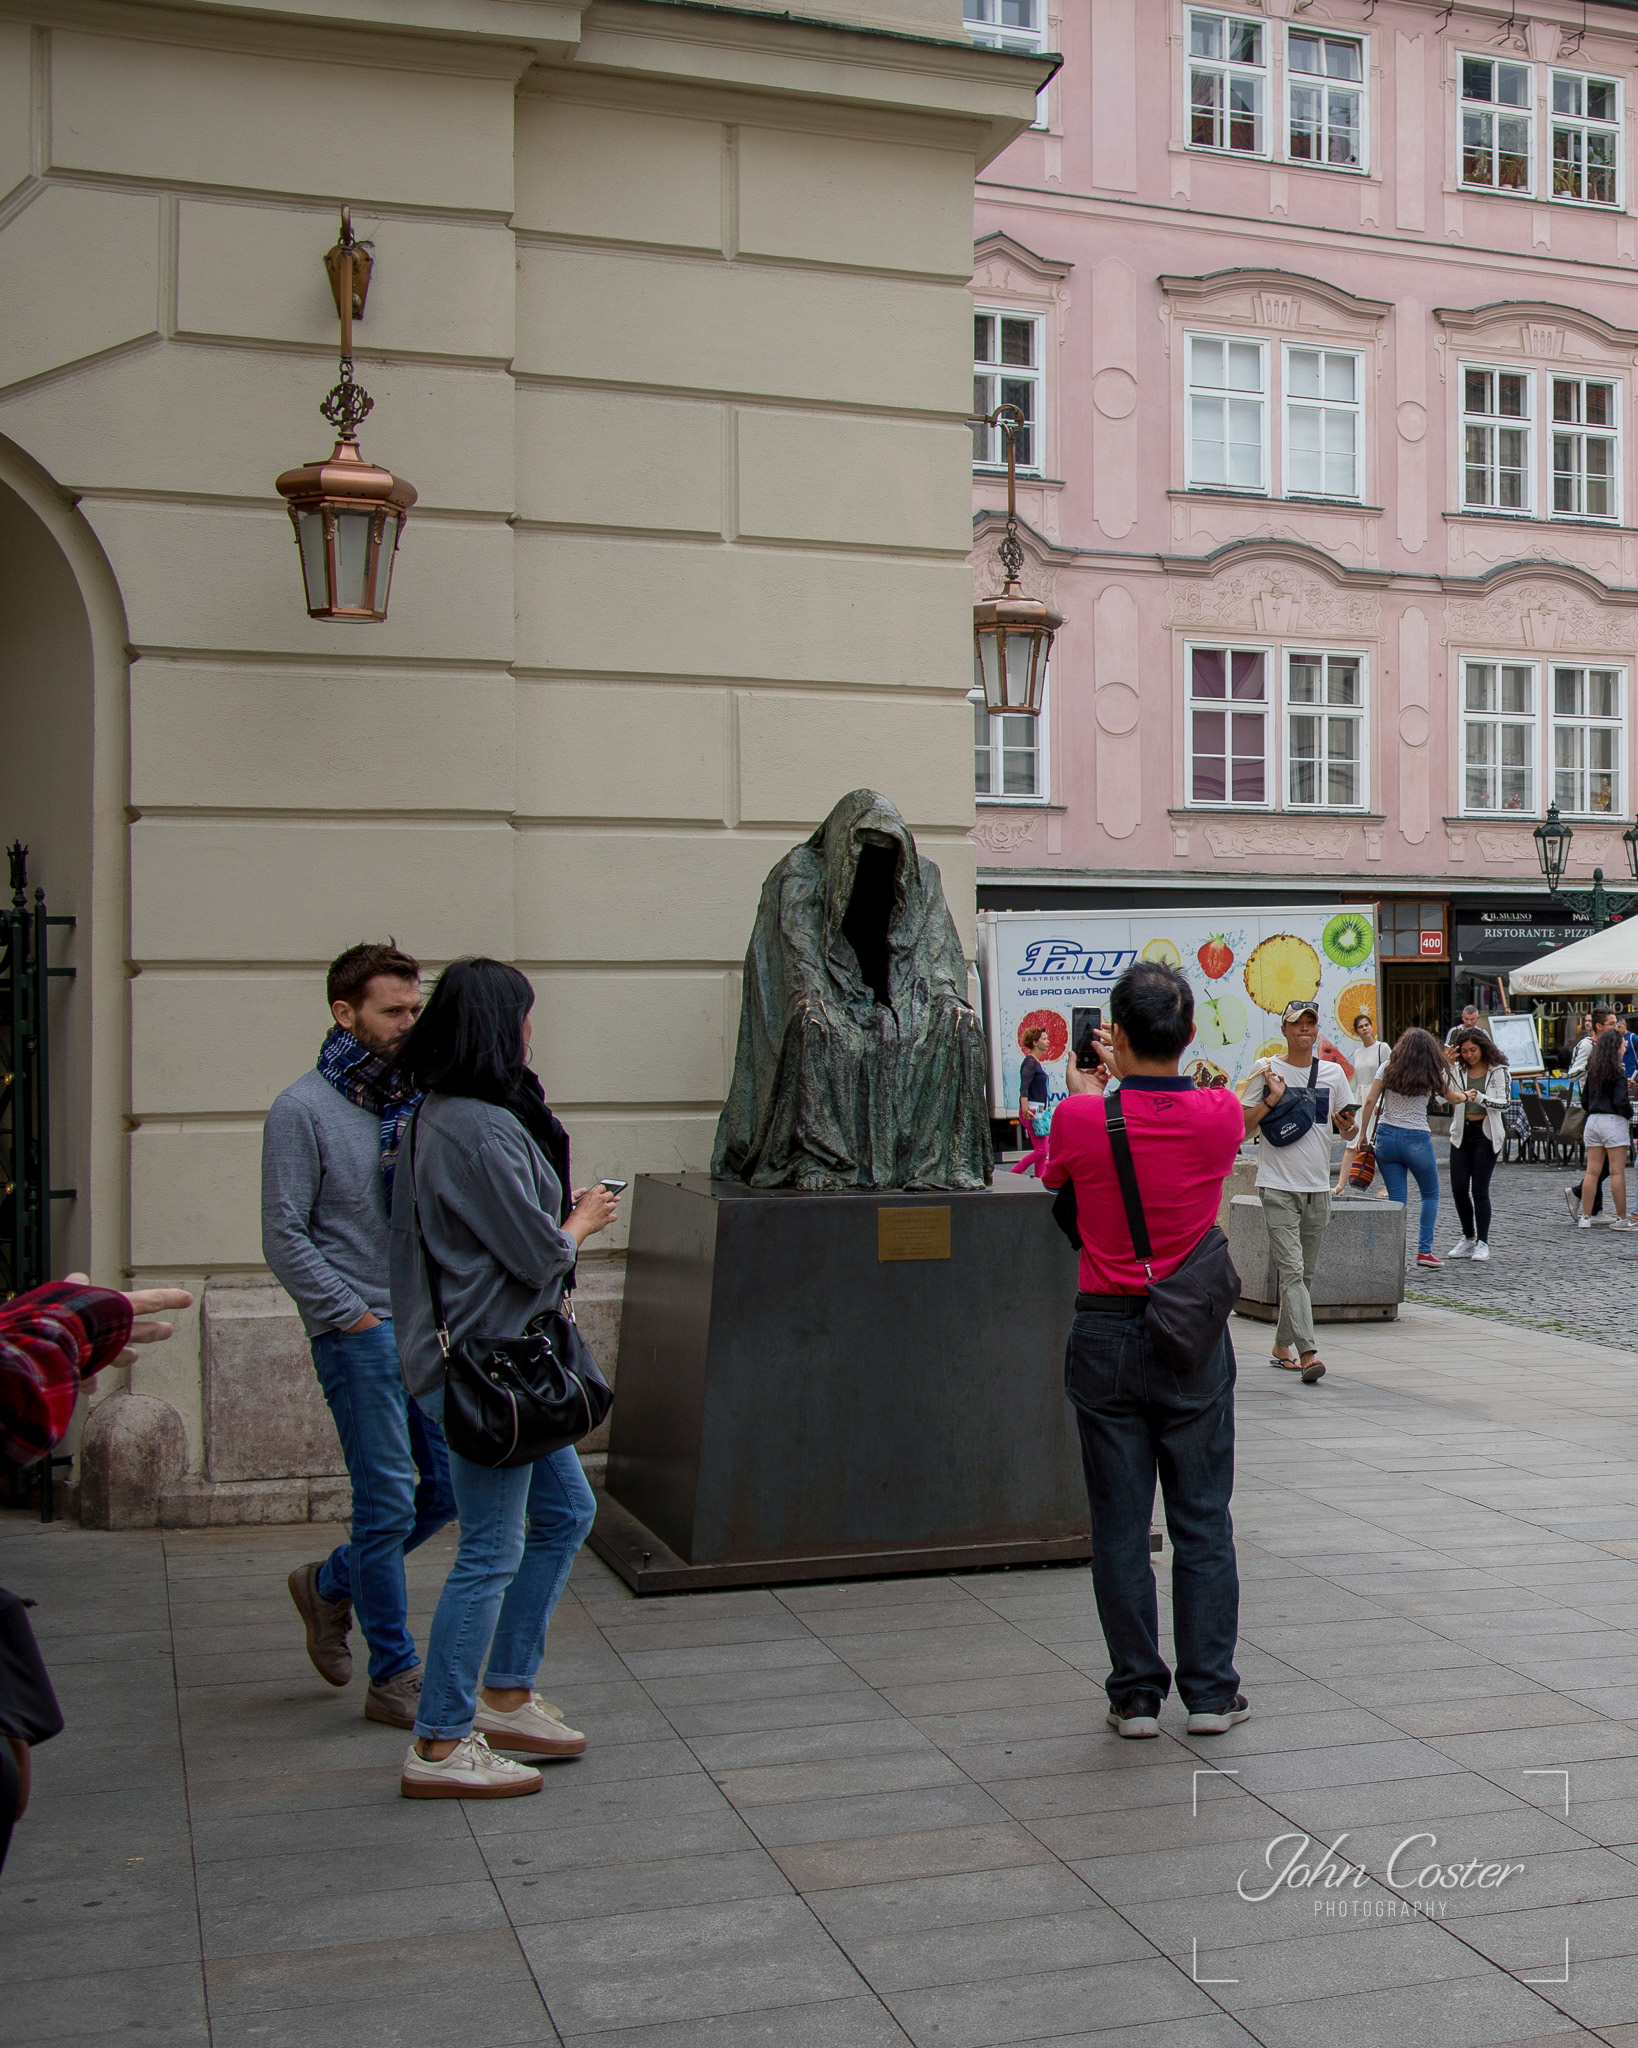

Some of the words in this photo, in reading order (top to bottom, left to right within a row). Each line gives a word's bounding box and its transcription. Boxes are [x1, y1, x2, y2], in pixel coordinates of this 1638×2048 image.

[1484, 928, 1555, 938] RISTORANTE
[1422, 938, 1441, 948] 400
[1016, 939, 1138, 981] Fany
[1519, 973, 1560, 988] MATTONI
[1017, 987, 1039, 997] VŠE
[1040, 988, 1062, 996] PRO
[1550, 1001, 1564, 1014] IL
